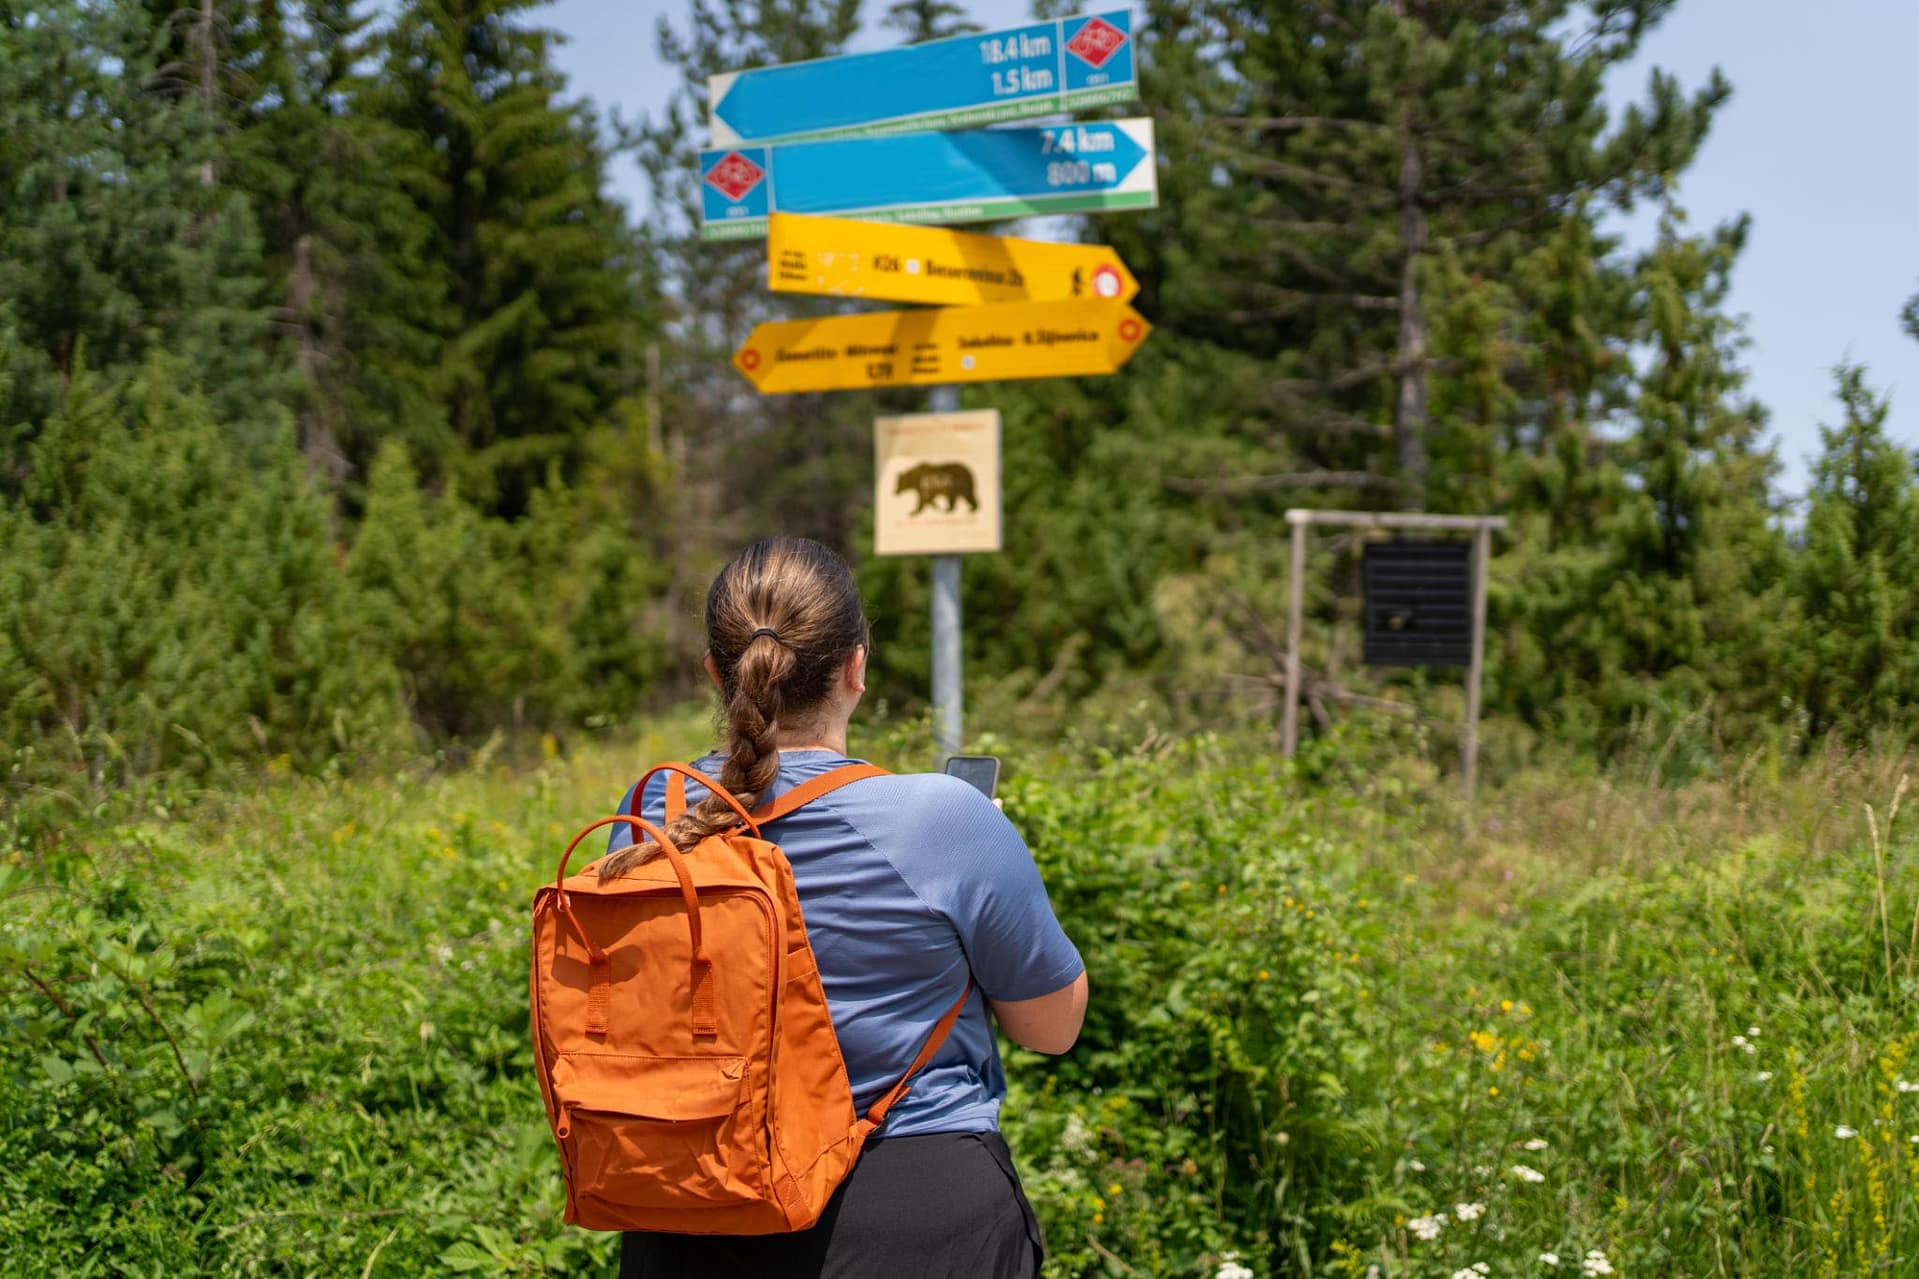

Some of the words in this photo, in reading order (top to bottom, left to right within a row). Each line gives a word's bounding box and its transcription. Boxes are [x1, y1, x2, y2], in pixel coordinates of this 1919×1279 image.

[1019, 32, 1051, 58] km
[991, 67, 1020, 95] 1.5
[1020, 65, 1053, 91] km
[1040, 128, 1075, 154] 7.4
[1076, 126, 1115, 152] km
[1046, 159, 1090, 187] 800
[1091, 162, 1118, 182] m
